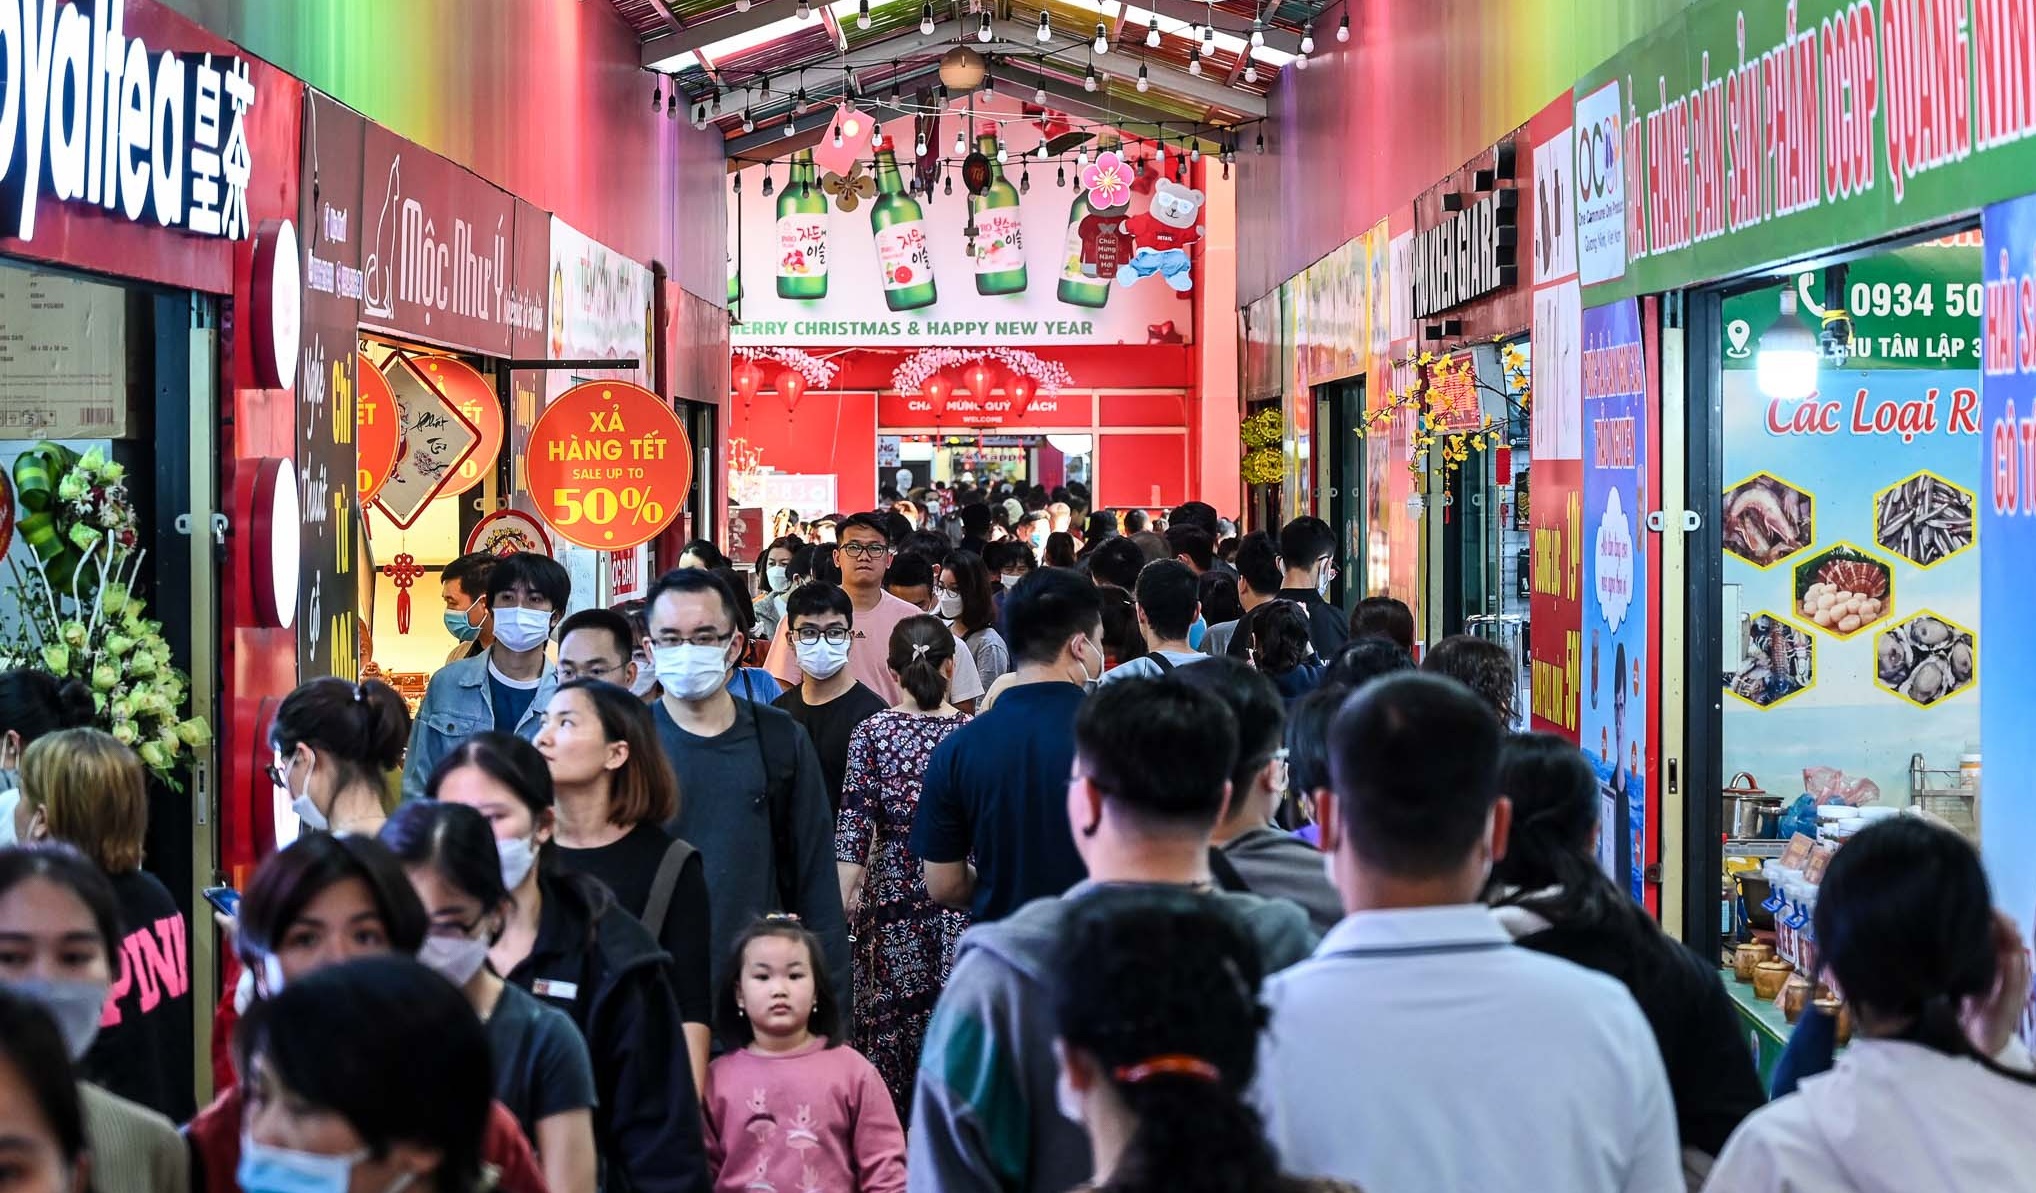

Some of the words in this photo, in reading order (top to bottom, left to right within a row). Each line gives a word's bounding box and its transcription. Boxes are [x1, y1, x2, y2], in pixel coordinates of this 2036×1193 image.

[1647, 76, 1691, 255] HÀNG
[1691, 50, 1726, 243] BÁN
[1727, 10, 1762, 233] SẢN
[1822, 0, 1878, 204] OCOP
[1973, 0, 2036, 151] NIN
[189, 52, 255, 241] 皇茶
[807, 245, 826, 265] 이슬
[1005, 229, 1022, 249] 이슬
[400, 198, 449, 325] Mộc
[453, 218, 491, 321] Như
[494, 214, 504, 323] Ý
[912, 250, 931, 270] 이슬
[1850, 283, 1933, 317] 0934
[1985, 249, 2016, 375] HẢI
[2020, 274, 2036, 373] S
[795, 321, 901, 335] CHRISTMAS
[908, 321, 920, 335] &
[927, 321, 988, 335] HAPPY
[995, 321, 1037, 335] NEW
[1045, 321, 1093, 335] YEAR
[1848, 338, 1872, 357] HU
[1878, 333, 1919, 358] TÂN
[1926, 333, 1964, 362] LẬP
[303, 332, 326, 440] Nghệ
[332, 352, 351, 445] Chỉ
[358, 394, 377, 426] ẾT
[410, 412, 448, 432] Phát
[458, 399, 483, 425] ẾT
[588, 403, 625, 433] XẢ
[908, 400, 933, 411] CH
[985, 400, 1011, 411] QUÝ
[1767, 390, 1841, 435] Các
[1850, 388, 1937, 443] Loại
[548, 434, 623, 462] HÀNG
[630, 429, 667, 460] TẾT
[981, 453, 1026, 462] Kapp
[1992, 399, 2018, 514] CÔ
[2021, 408, 2036, 513] T
[572, 468, 602, 480] SALE
[606, 468, 622, 480] UP
[627, 468, 644, 480] TO
[302, 451, 329, 537] Thuật
[553, 486, 664, 526] 50%
[334, 484, 349, 574] Từ
[99, 912, 189, 1028] PIN
